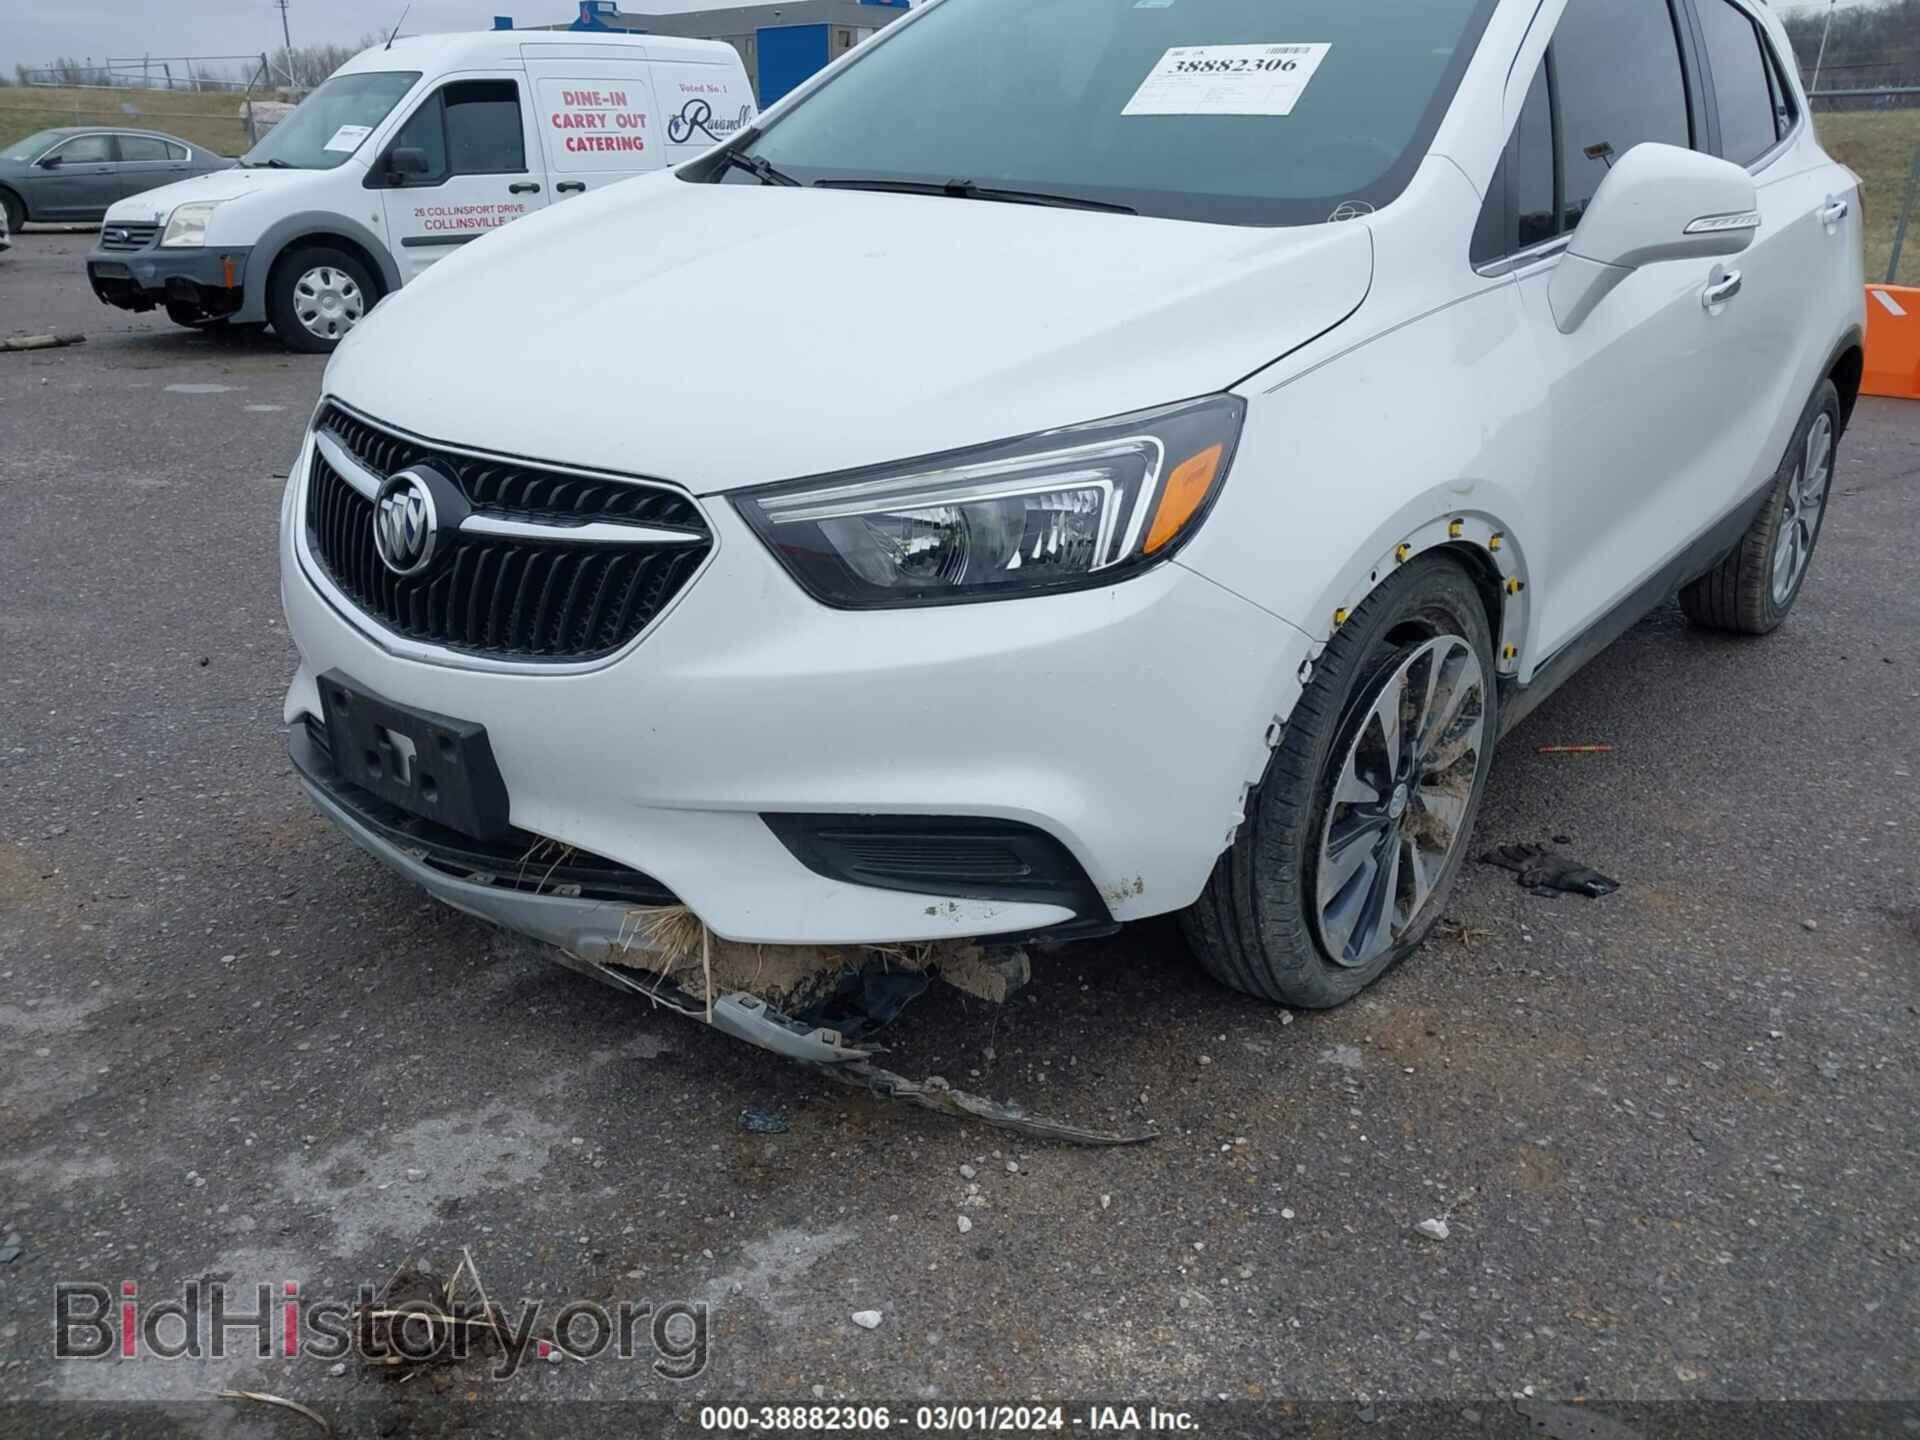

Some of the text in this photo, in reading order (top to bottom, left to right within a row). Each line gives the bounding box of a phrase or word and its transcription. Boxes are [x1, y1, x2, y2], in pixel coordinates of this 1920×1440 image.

[1168, 59, 1297, 73] 38882306
[680, 83, 704, 93] Voted
[562, 91, 627, 106] DINE-IN
[552, 113, 647, 128] CARRY OUT
[566, 137, 644, 151] CATERING
[414, 204, 524, 217] 26 COLLINSPORT DRIVE
